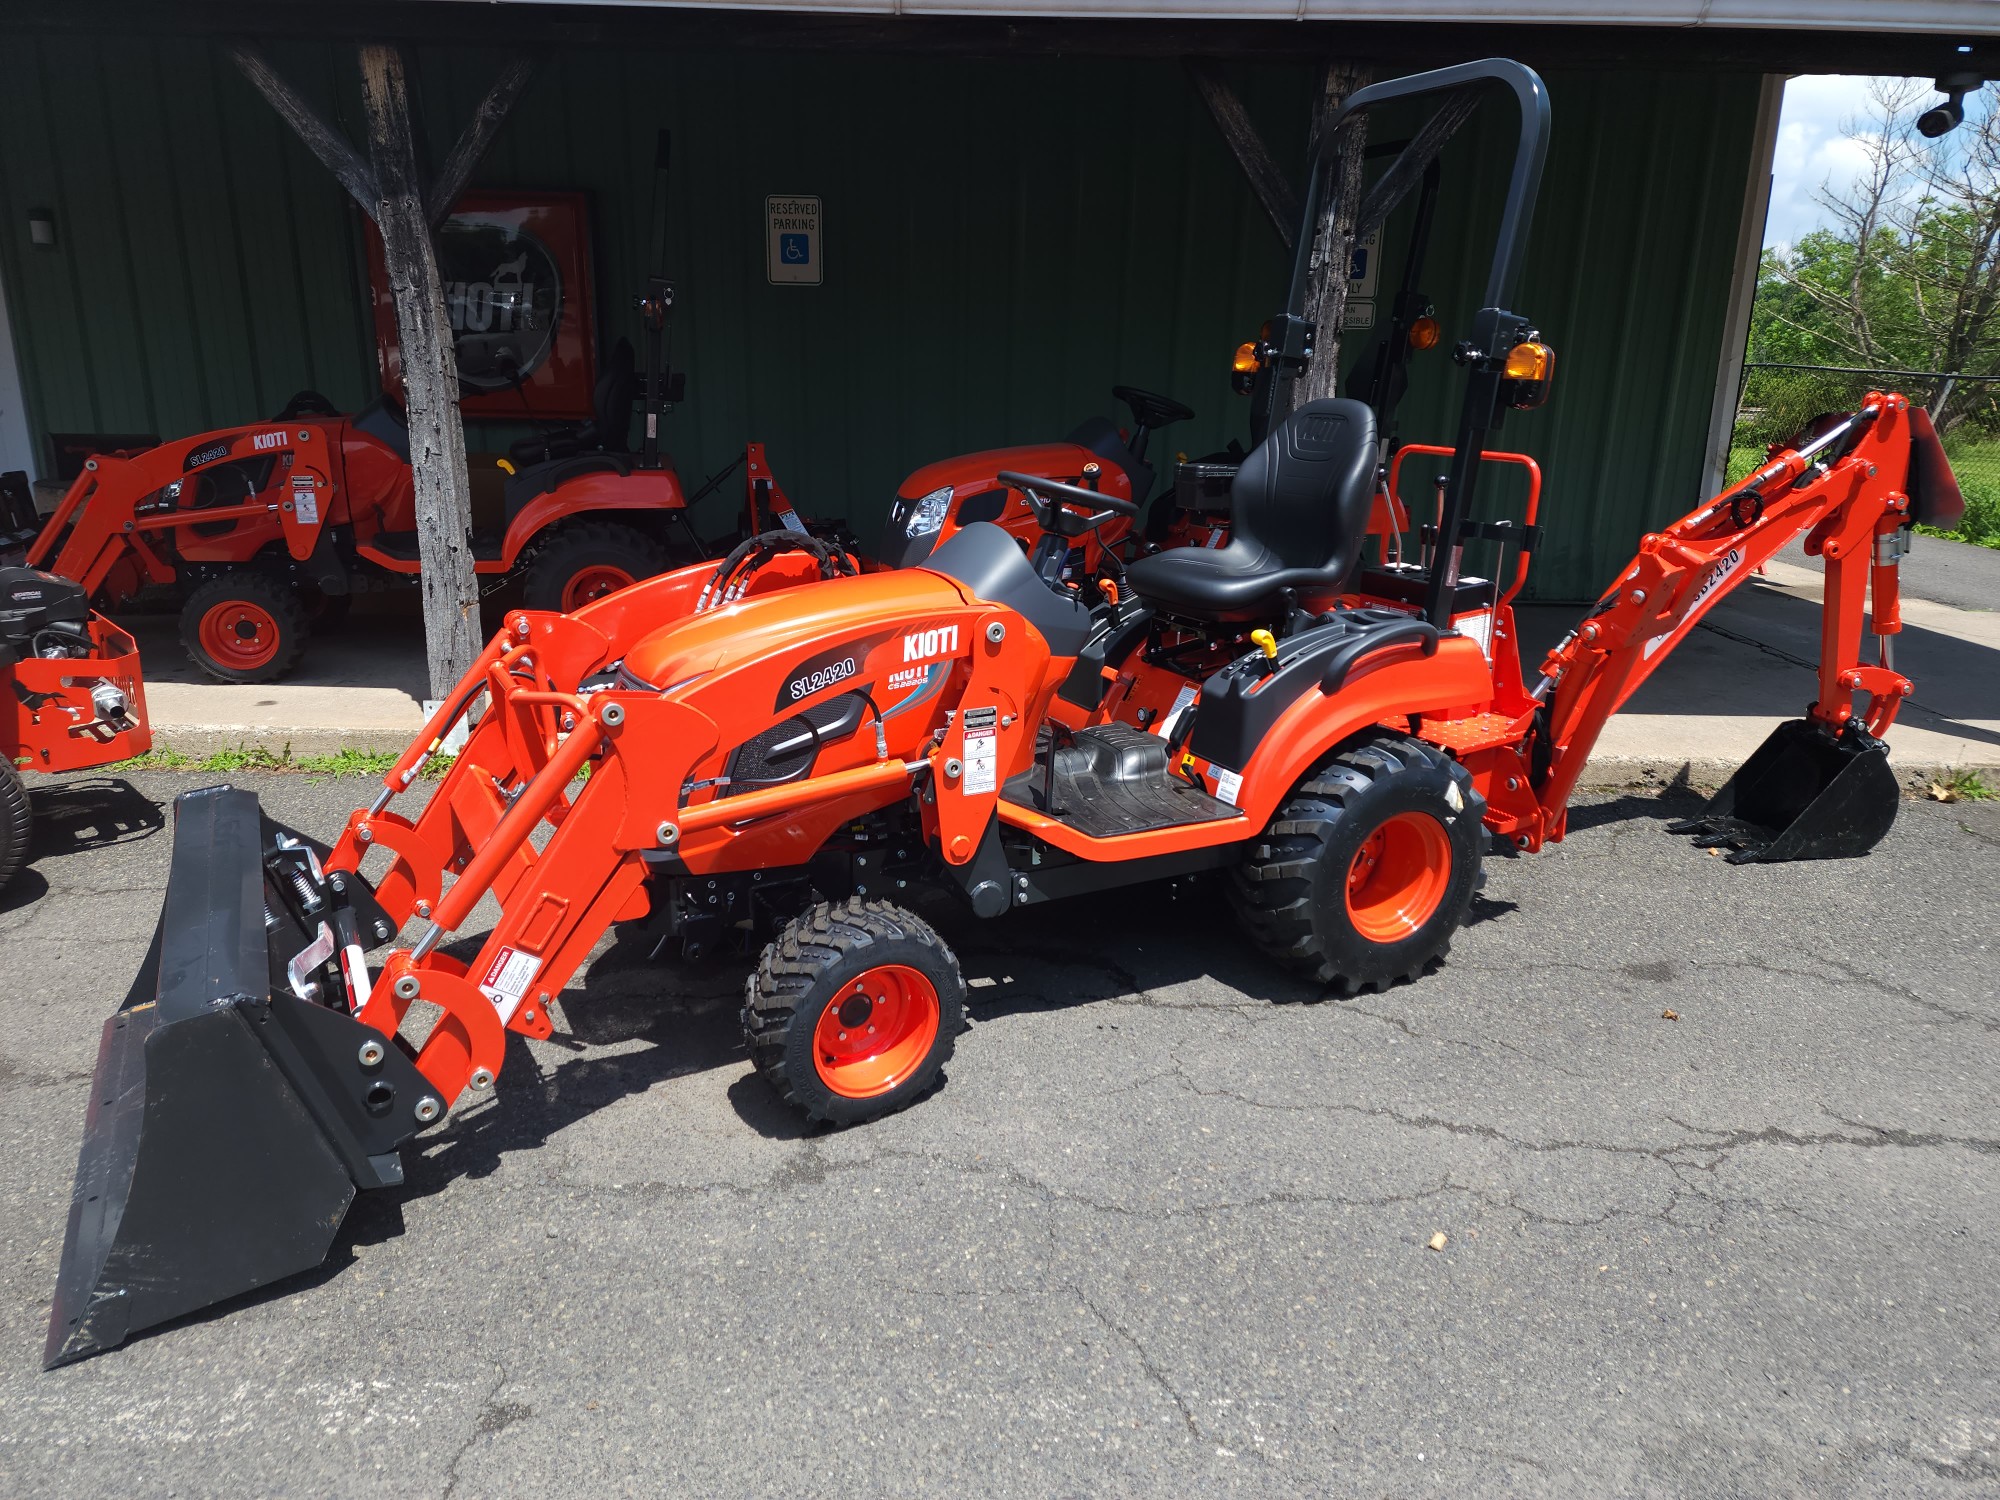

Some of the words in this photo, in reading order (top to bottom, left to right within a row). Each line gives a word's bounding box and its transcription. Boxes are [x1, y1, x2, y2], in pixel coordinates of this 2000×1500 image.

[770, 203, 818, 215] RESERVED
[773, 218, 815, 230] PARKING
[446, 281, 533, 331] IOTI
[253, 431, 288, 450] KIOTI
[189, 445, 227, 467] SL2420
[903, 625, 958, 663] KIOTI
[790, 657, 856, 700] SL2420
[887, 676, 929, 691] CS2220S
[492, 951, 510, 977] DANGER
